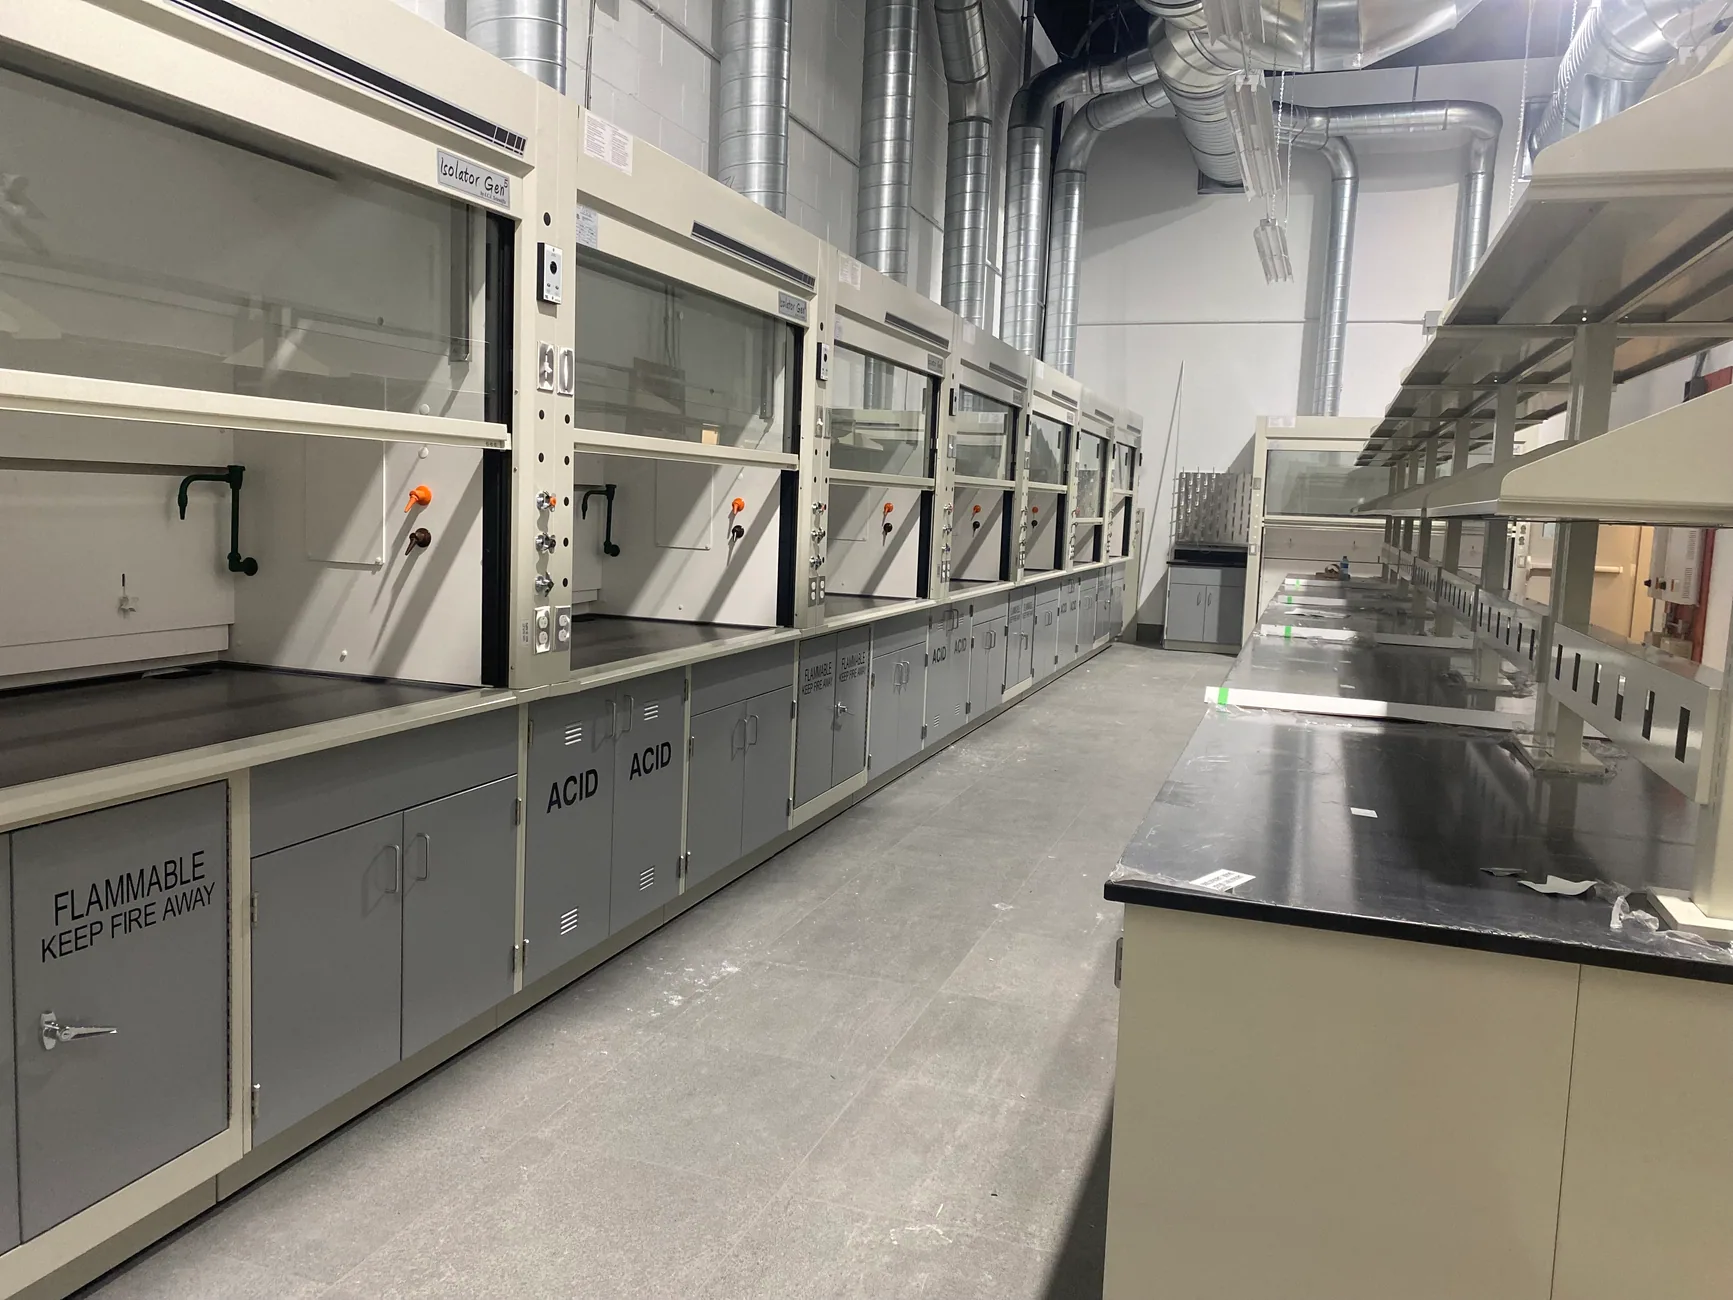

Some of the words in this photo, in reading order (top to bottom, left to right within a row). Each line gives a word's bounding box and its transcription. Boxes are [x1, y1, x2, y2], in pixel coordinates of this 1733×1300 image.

[440, 156, 480, 187] Isolator
[932, 646, 946, 664] ACID
[954, 638, 967, 654] ACID
[804, 661, 832, 682] FLAMMABLE
[802, 682, 813, 696] KEEP
[813, 679, 823, 692] FIRE
[629, 741, 672, 781] ACID
[546, 768, 598, 814] ACID
[54, 850, 205, 926] FLAMMABLE
[41, 920, 103, 963] KEEP
[111, 901, 156, 939] FIRE
[162, 881, 215, 922] AWAY
